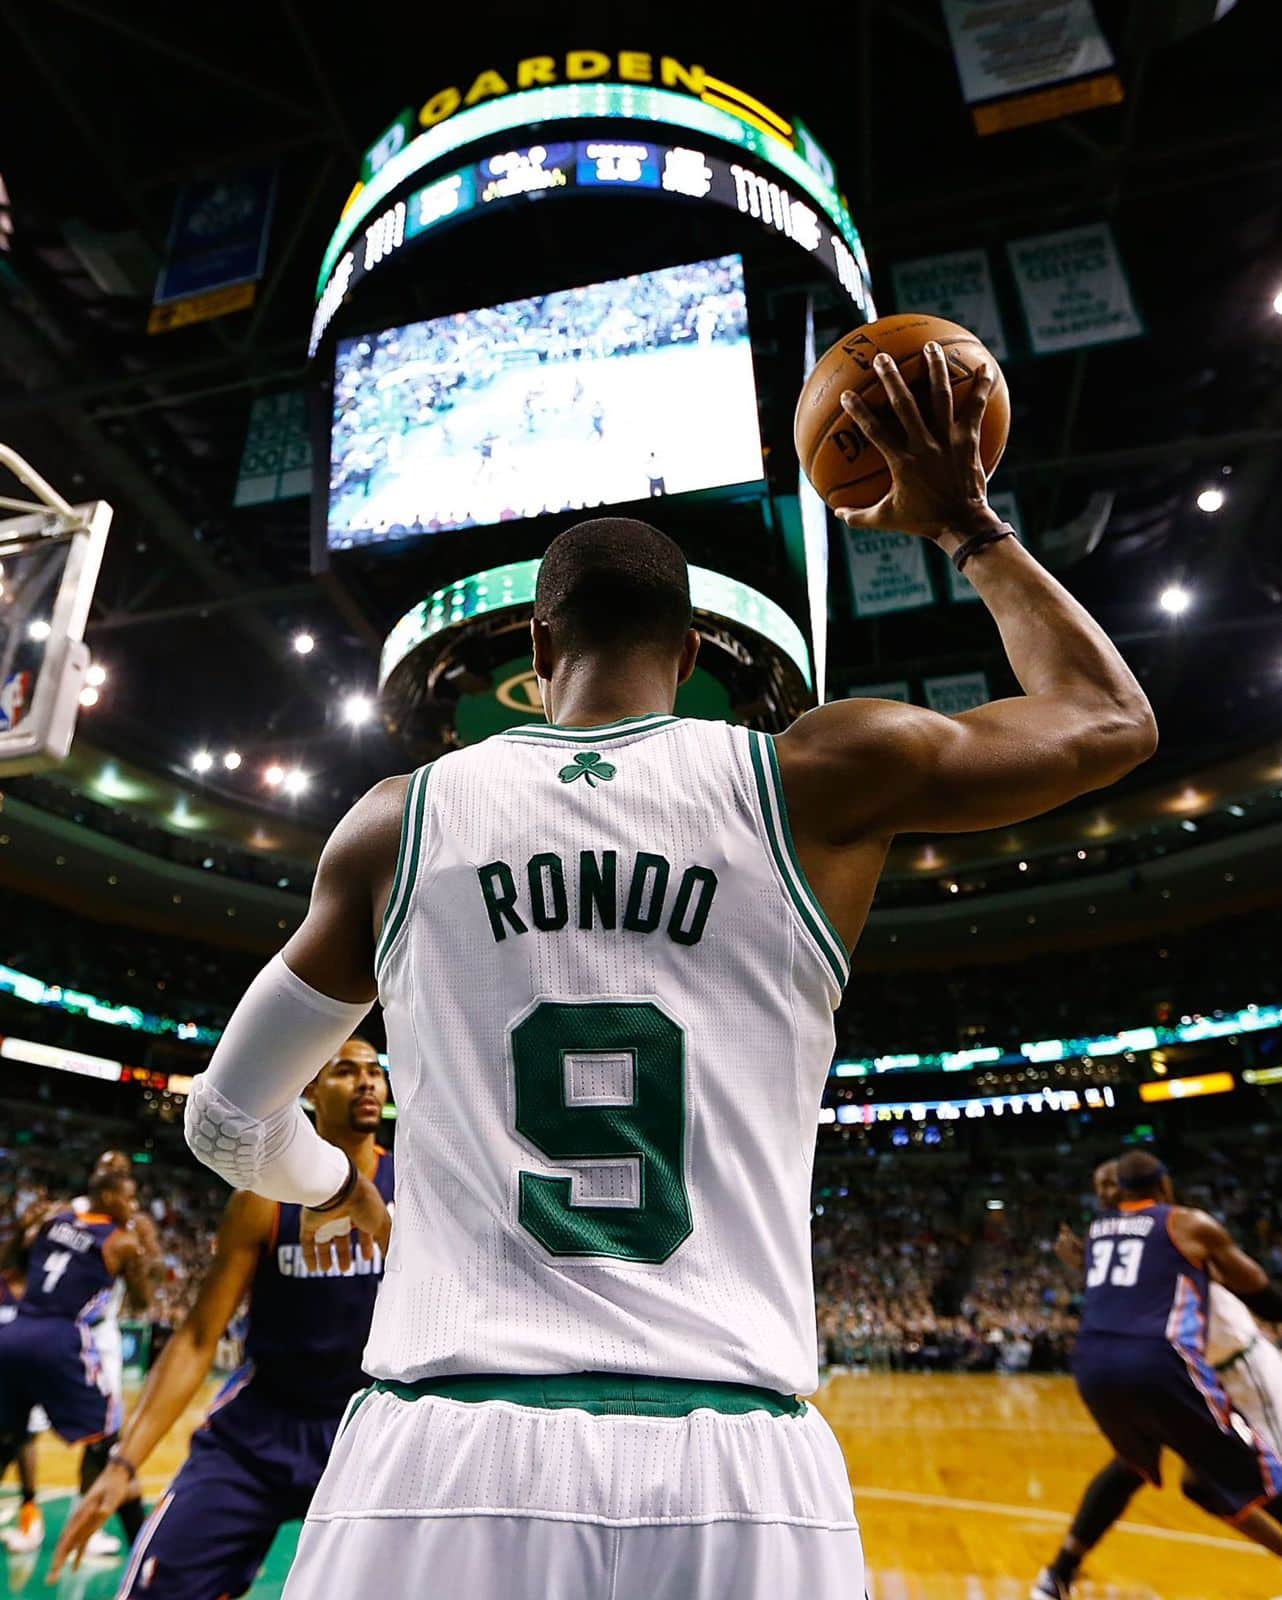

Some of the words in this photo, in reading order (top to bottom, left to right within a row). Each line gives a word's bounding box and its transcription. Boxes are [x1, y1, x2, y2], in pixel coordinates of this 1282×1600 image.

[417, 50, 705, 127] GARDEN
[477, 850, 719, 946] RONDO
[508, 999, 694, 1266] 9
[1086, 1239, 1146, 1288] 33
